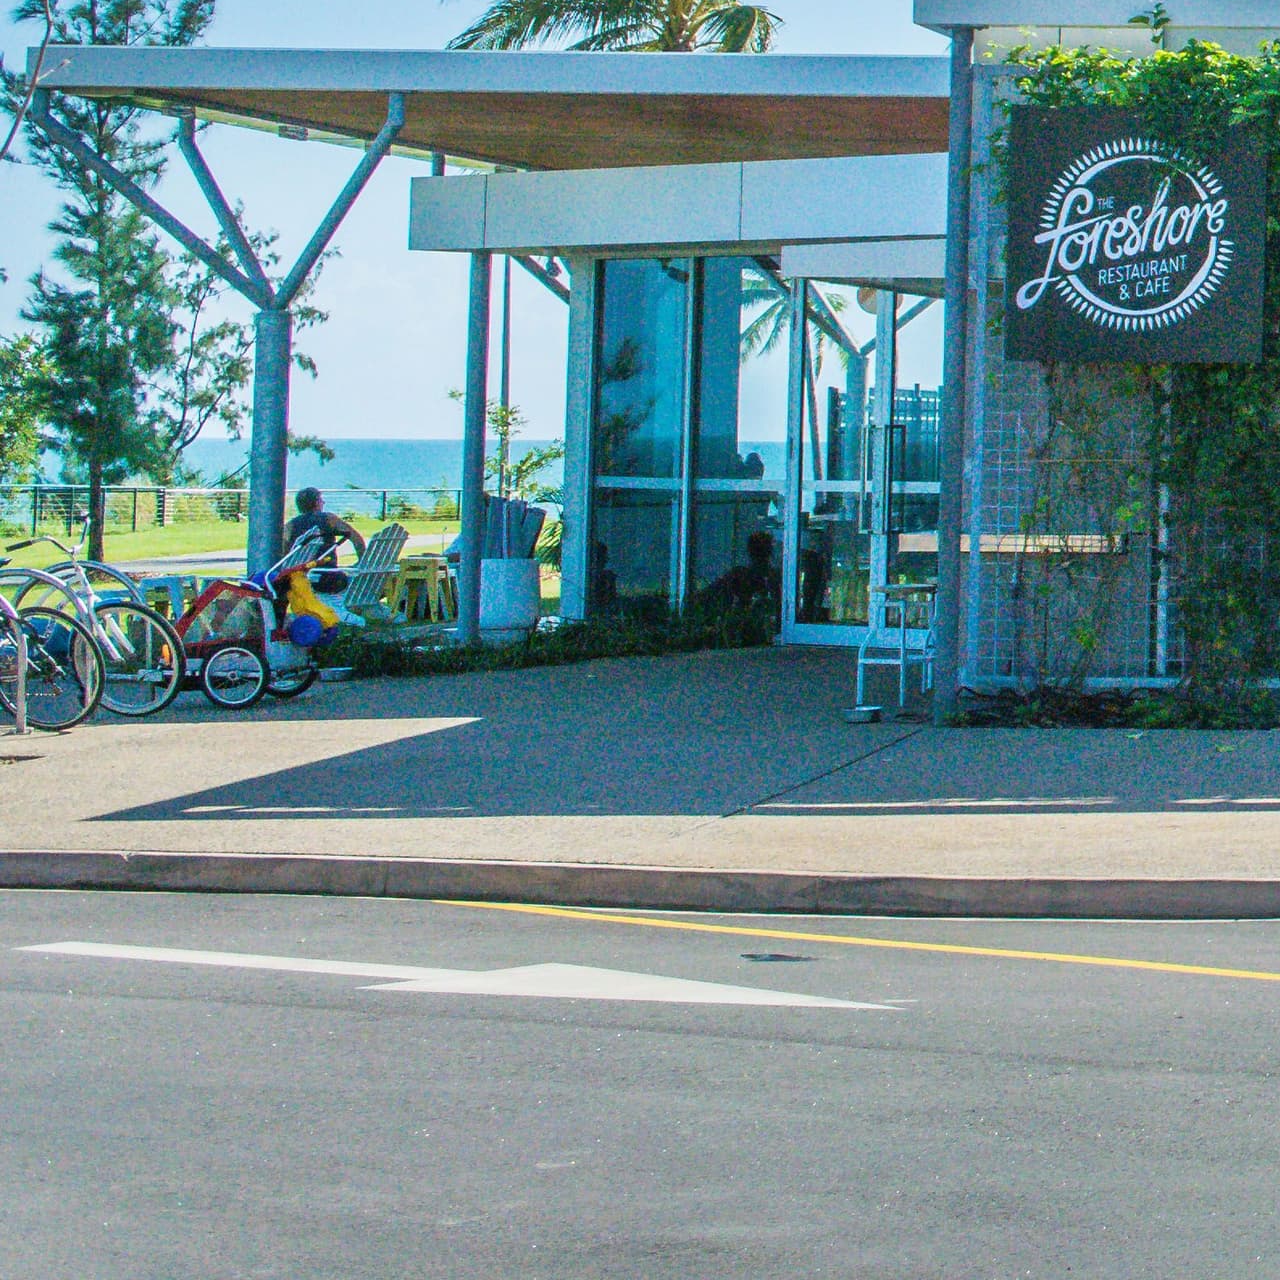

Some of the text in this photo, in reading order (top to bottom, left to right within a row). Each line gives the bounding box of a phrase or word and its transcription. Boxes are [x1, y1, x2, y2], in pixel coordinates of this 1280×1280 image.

[1097, 196, 1115, 210] THE
[1016, 176, 1228, 309] Foreshore
[1098, 255, 1188, 286] RESTAURANT
[1119, 276, 1170, 300] & CAFE
